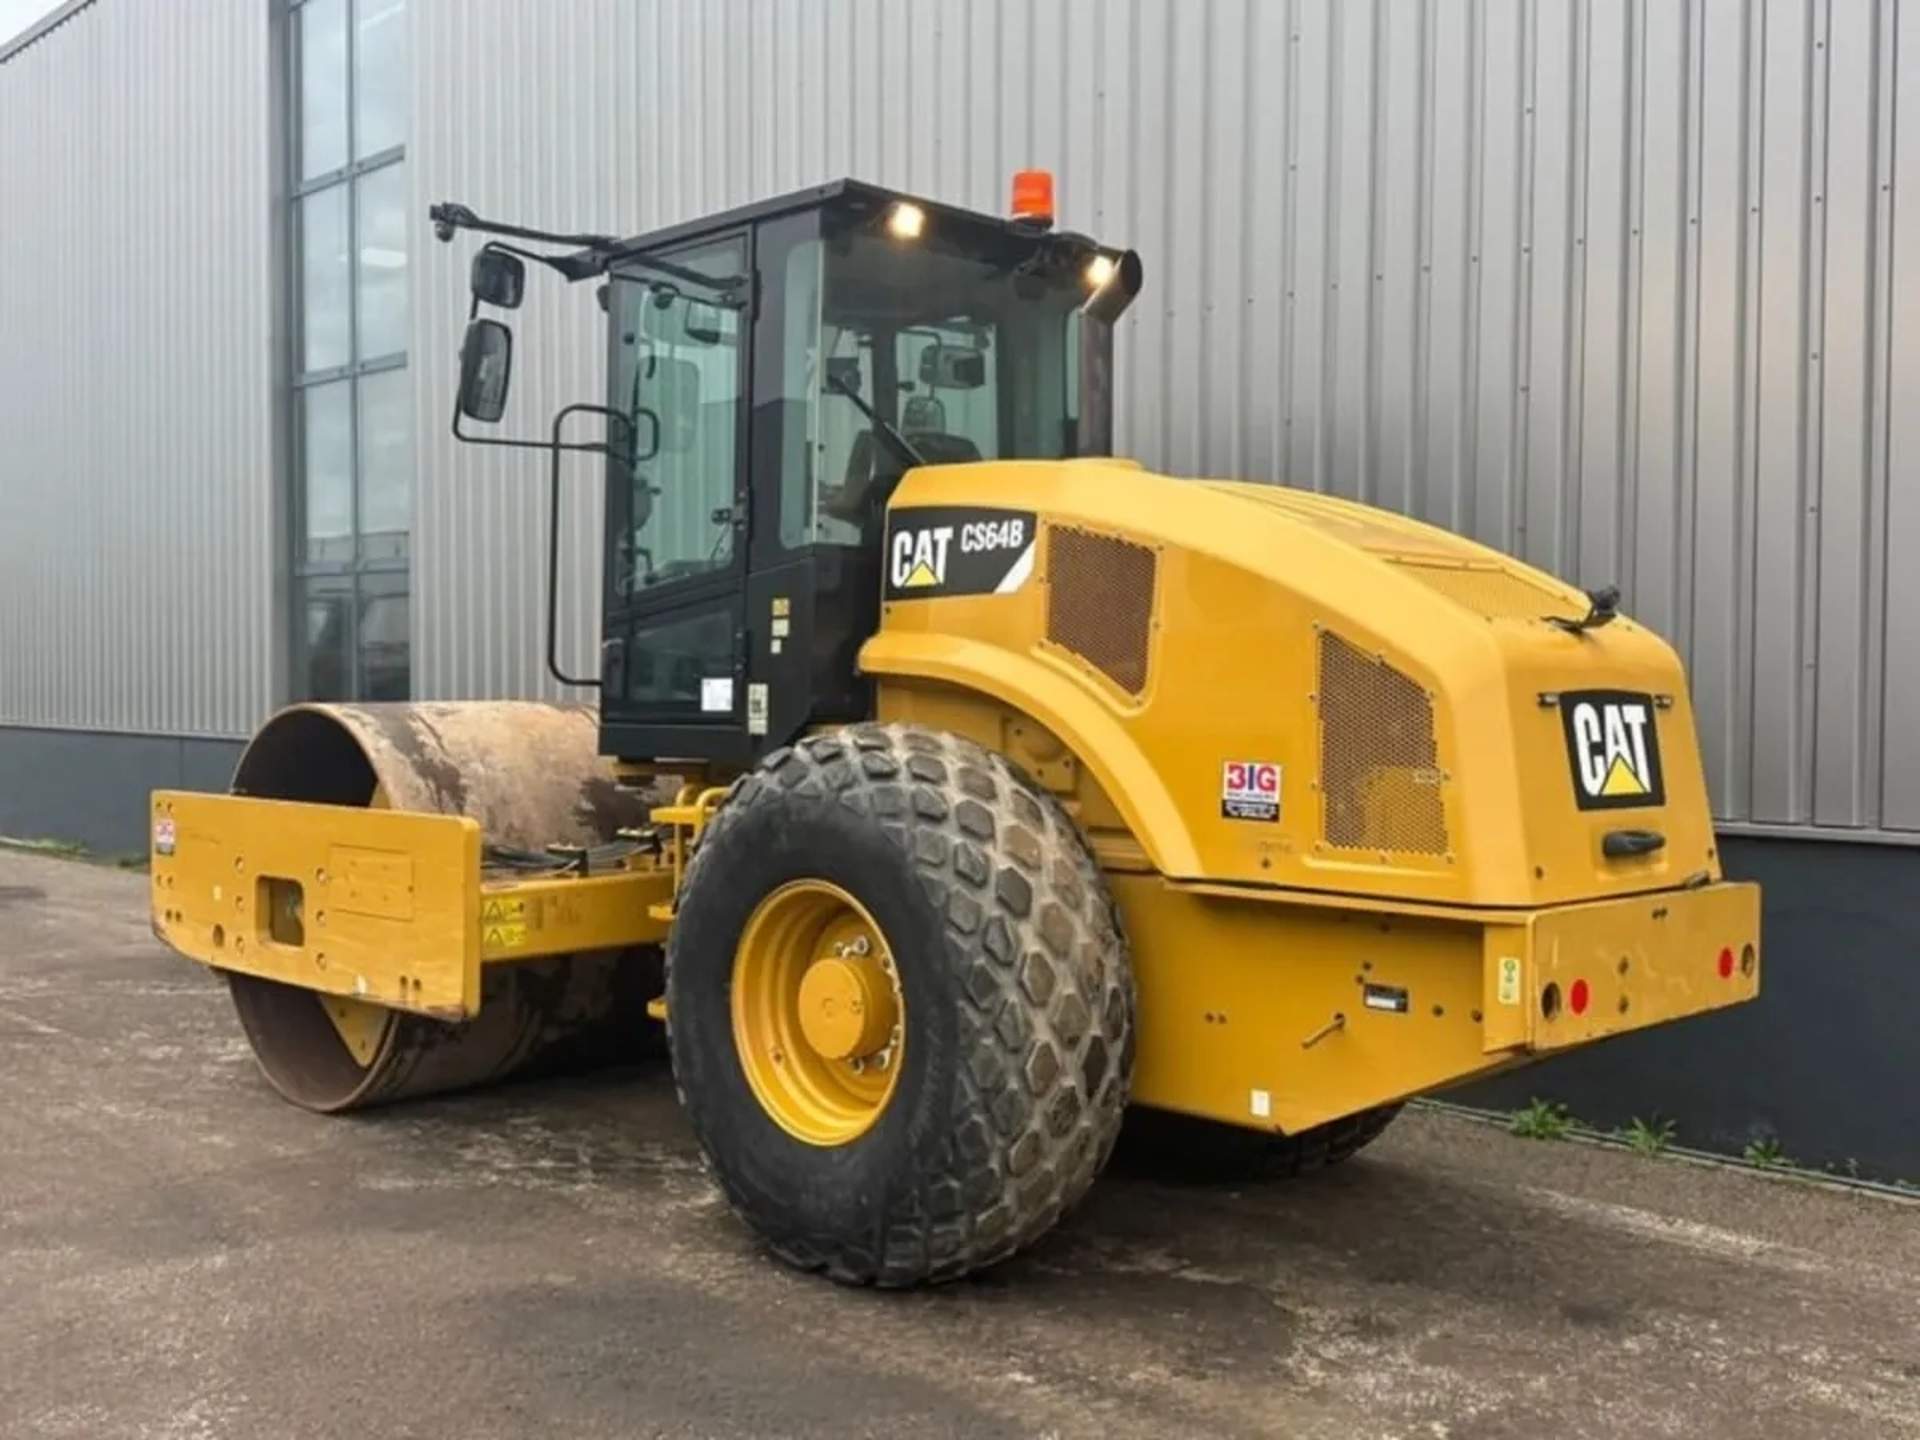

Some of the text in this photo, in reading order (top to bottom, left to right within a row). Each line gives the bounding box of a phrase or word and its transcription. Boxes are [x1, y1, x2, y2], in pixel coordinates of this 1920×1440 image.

[891, 519, 1023, 587] CAT CS64B
[1573, 702, 1652, 796] CAT
